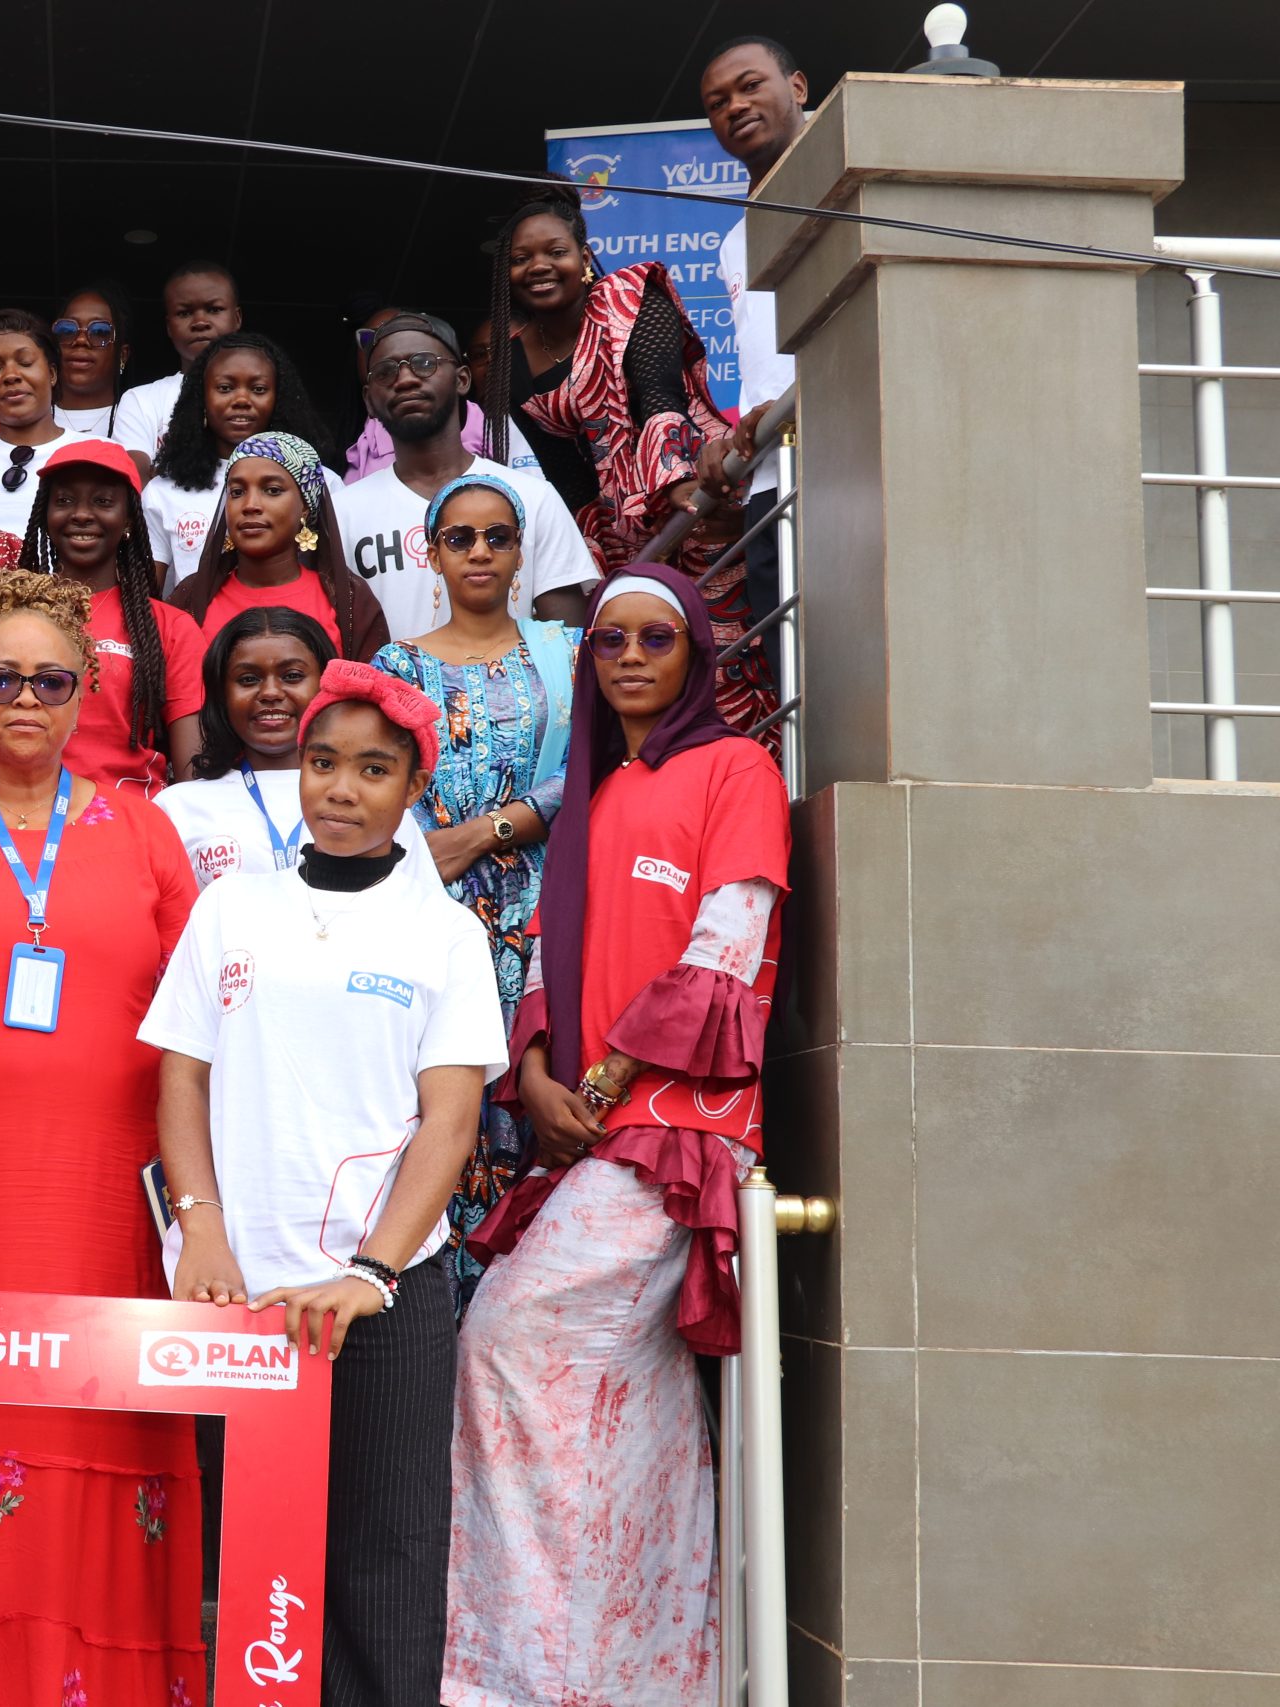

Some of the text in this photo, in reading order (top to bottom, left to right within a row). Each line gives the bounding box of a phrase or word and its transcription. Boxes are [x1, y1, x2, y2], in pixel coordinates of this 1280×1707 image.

[661, 155, 752, 185] YOUTH
[586, 231, 721, 255] OUTH ENG
[670, 262, 726, 282] ATF
[688, 308, 735, 328] EFO
[178, 518, 205, 536] Mai
[199, 841, 234, 870] Mai
[204, 857, 235, 873] Rouge
[659, 865, 687, 886] PLAN
[377, 977, 412, 1000] PLAN
[206, 1342, 291, 1369] PLAN
[206, 1370, 290, 1382] INTERNATIONAL
[244, 1574, 306, 1687] Rouge
